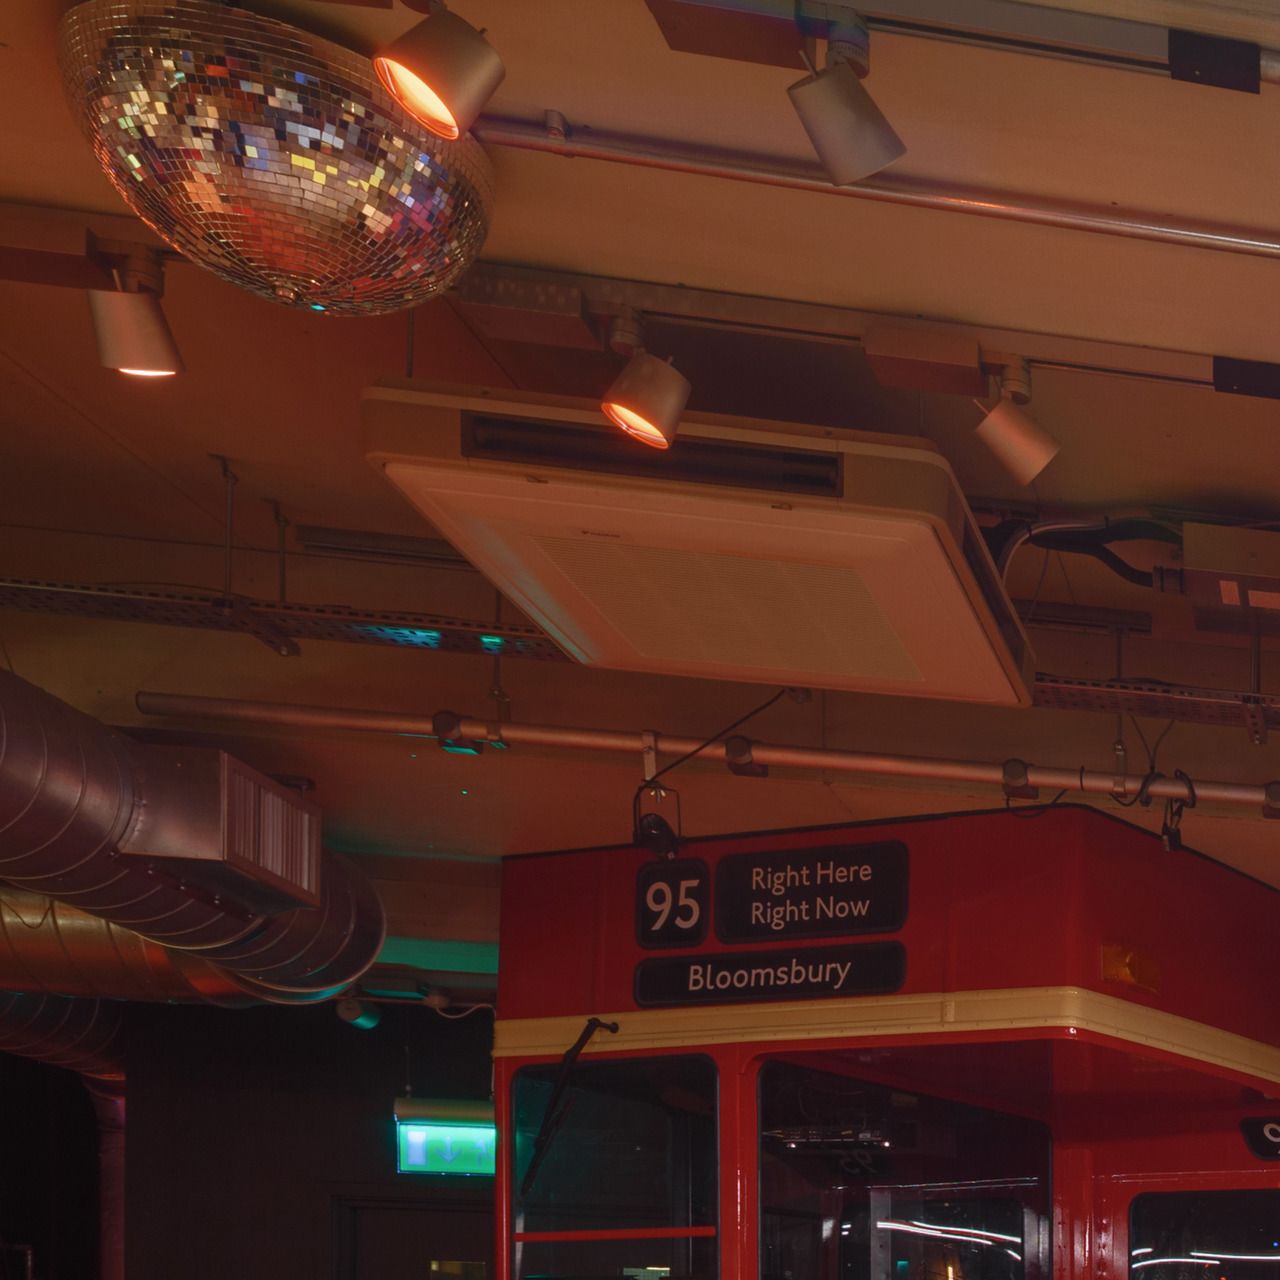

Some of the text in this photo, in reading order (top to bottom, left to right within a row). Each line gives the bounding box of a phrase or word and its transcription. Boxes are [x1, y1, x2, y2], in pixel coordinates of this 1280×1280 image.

[752, 860, 872, 896] Right Here
[646, 879, 700, 931] 95
[751, 896, 870, 930] Right Now
[688, 958, 851, 992] Bloomsbury
